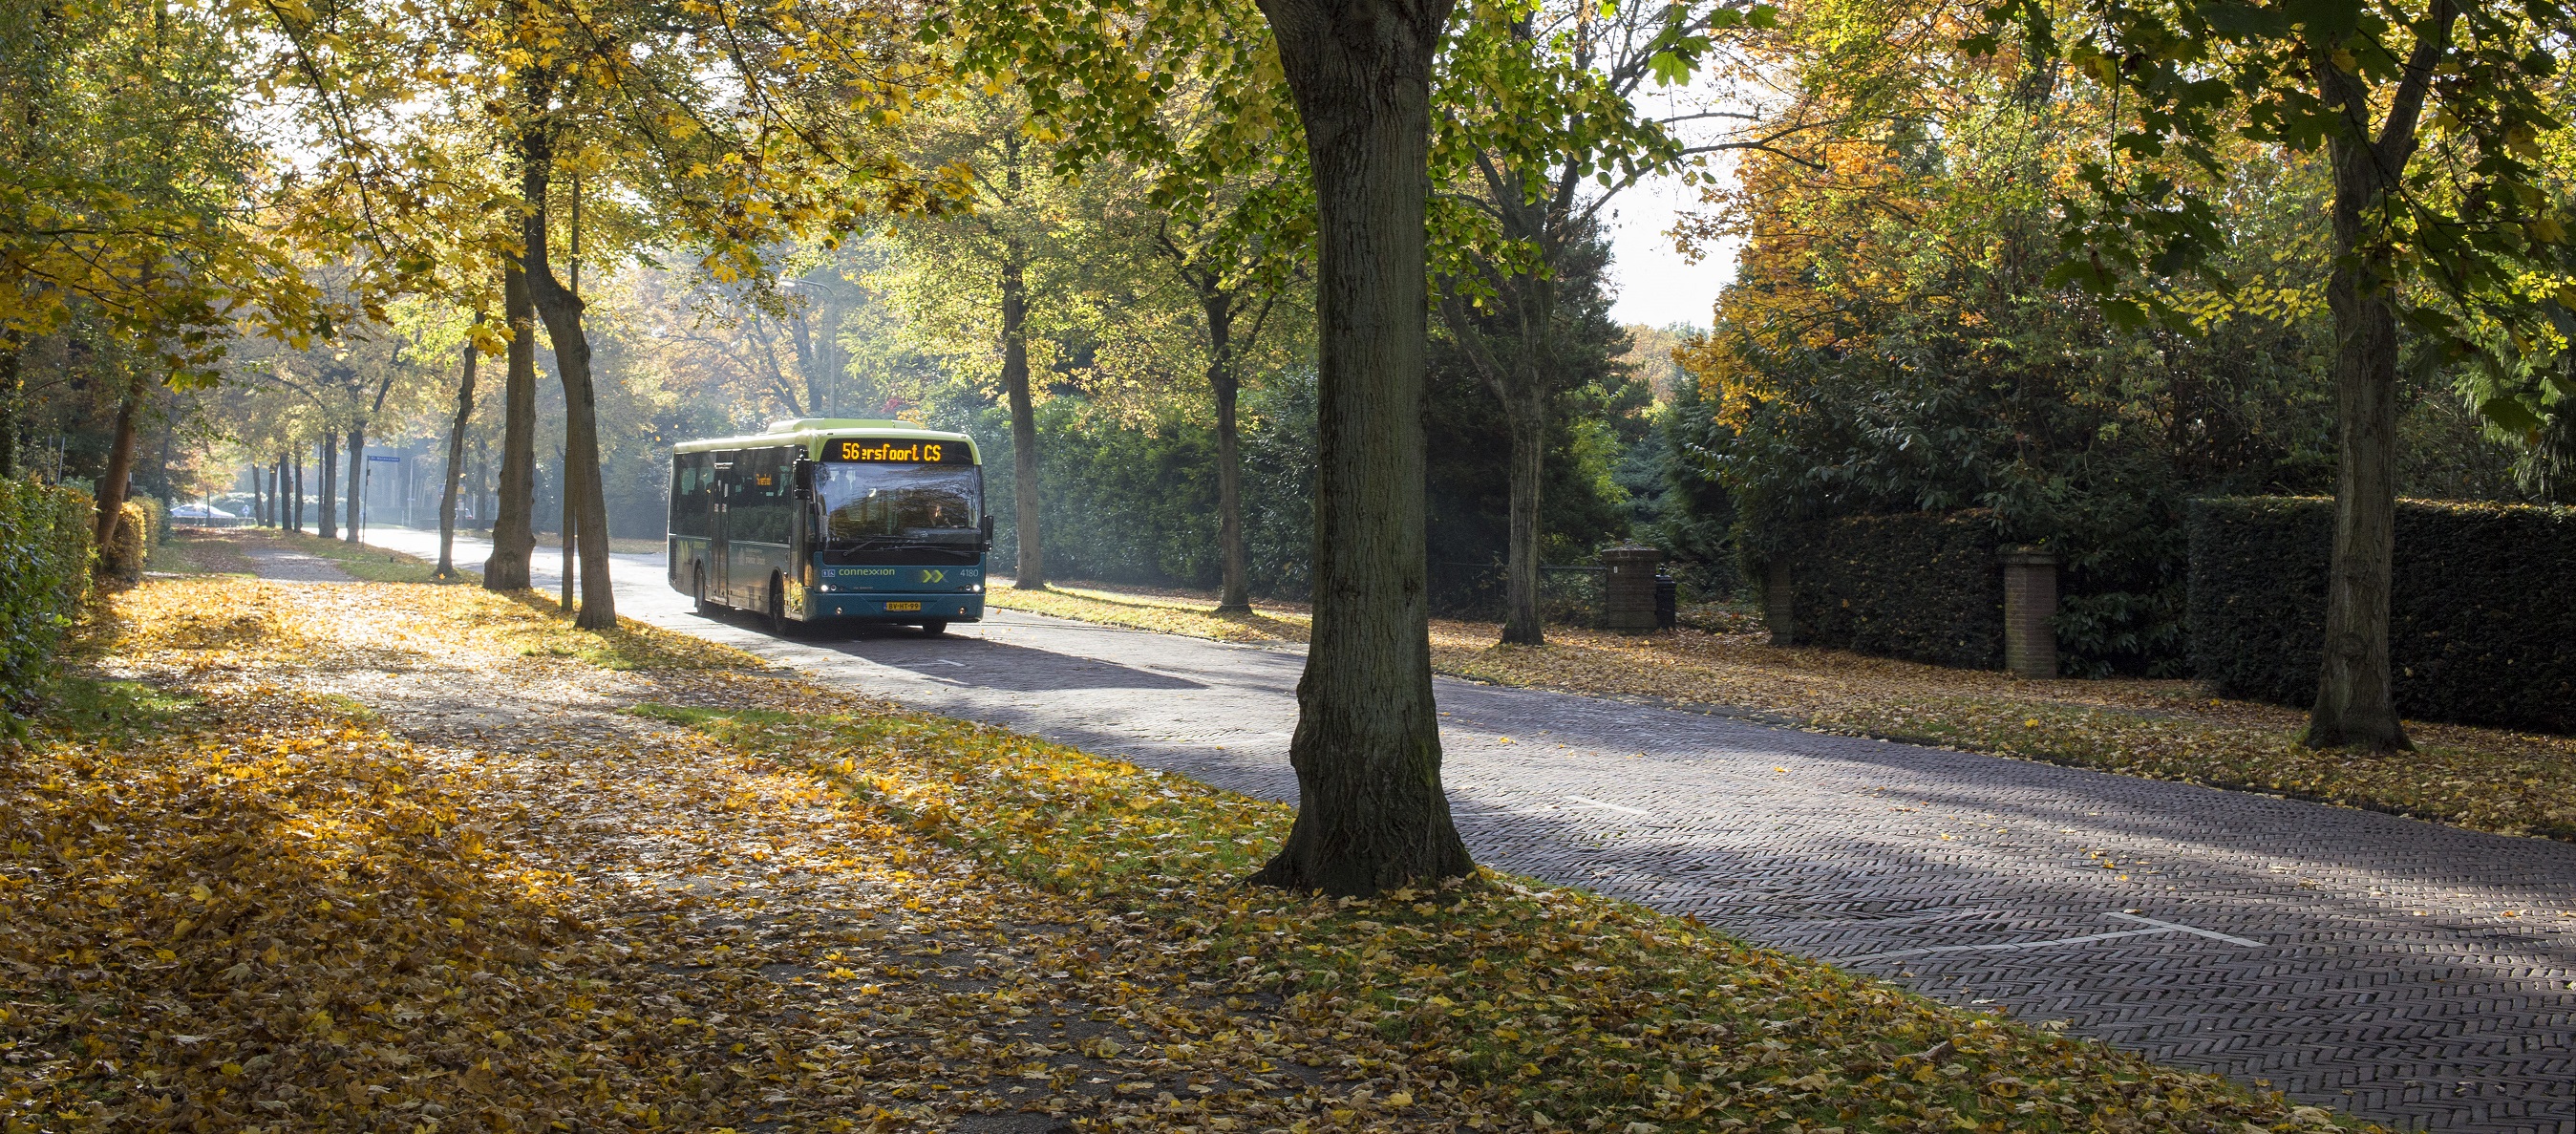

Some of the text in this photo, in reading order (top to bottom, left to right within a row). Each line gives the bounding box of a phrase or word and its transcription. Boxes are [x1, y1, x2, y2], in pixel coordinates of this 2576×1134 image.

[841, 442, 860, 460] 56
[924, 444, 942, 461] CS
[959, 568, 979, 578] 4180
